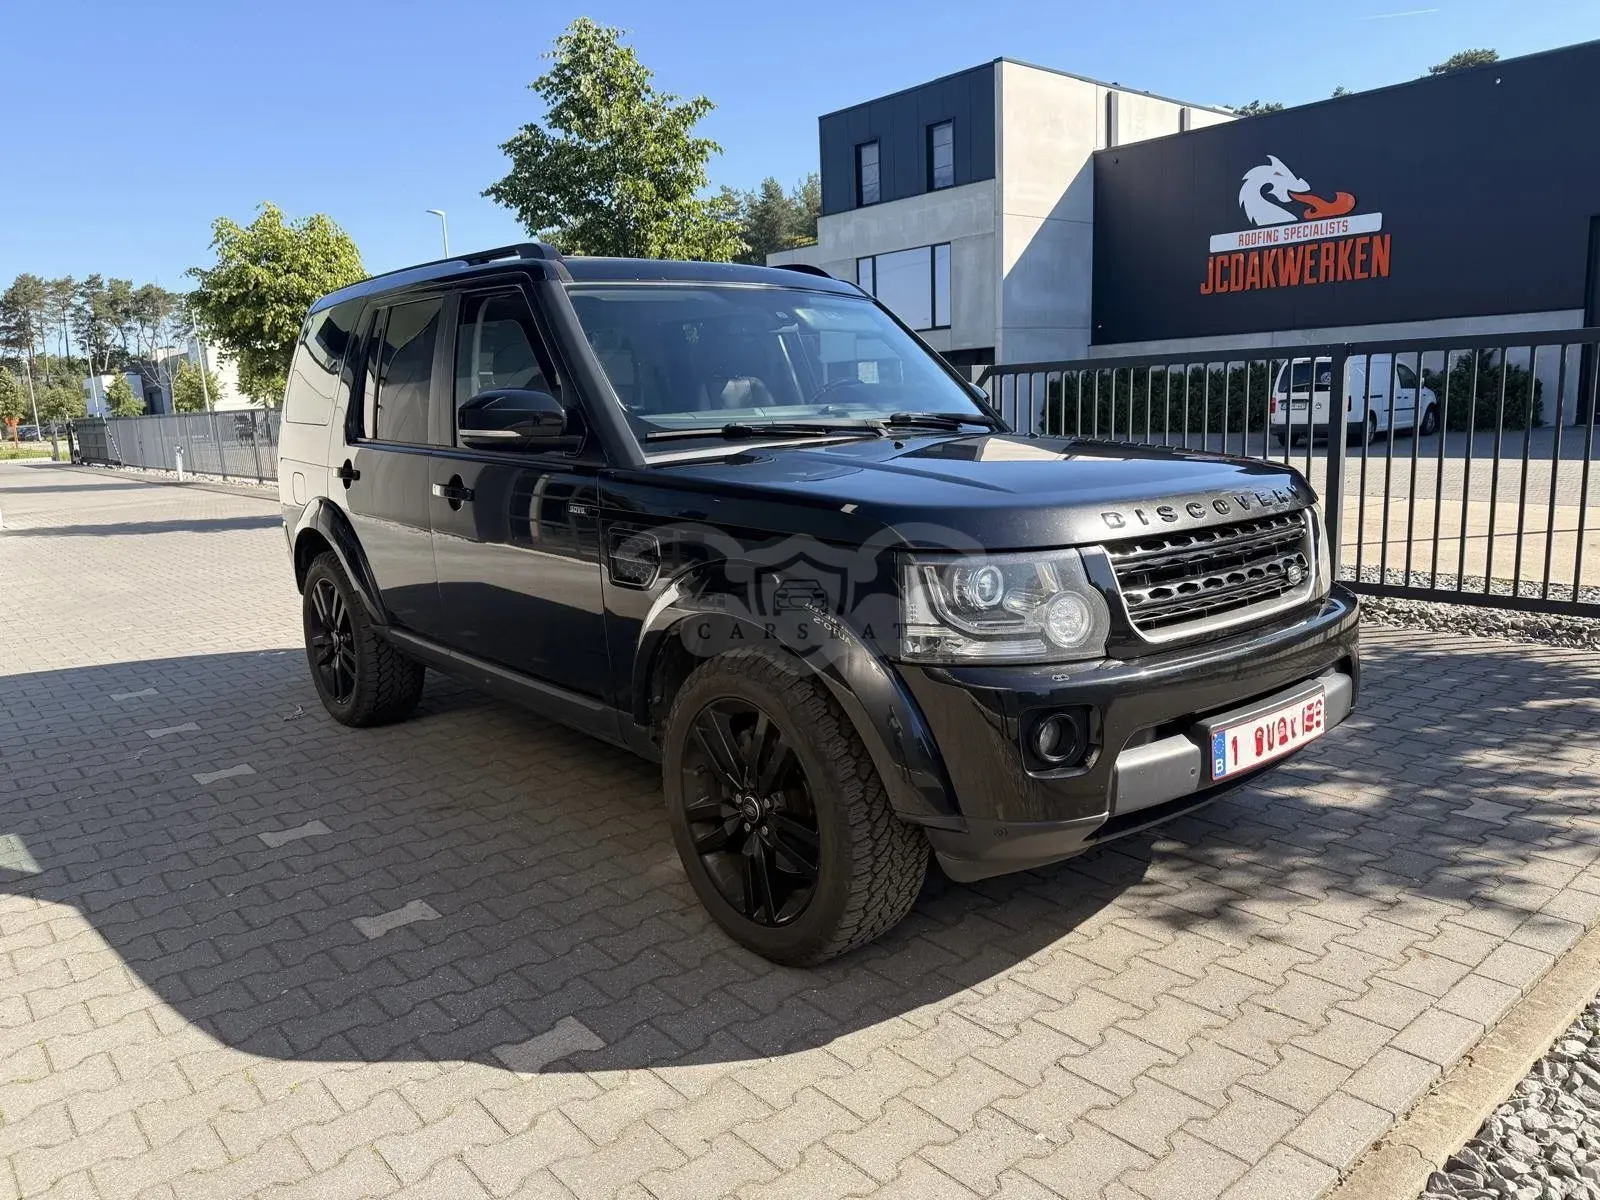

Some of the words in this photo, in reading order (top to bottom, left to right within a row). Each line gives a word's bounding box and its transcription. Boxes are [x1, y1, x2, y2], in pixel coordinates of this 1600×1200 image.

[1238, 229, 1279, 248] ROOFING
[1283, 219, 1349, 241] SPECIALISTS
[1200, 234, 1392, 295] JCDAKWERKEN
[1101, 485, 1298, 529] DISCOVERY
[1215, 758, 1224, 774] B
